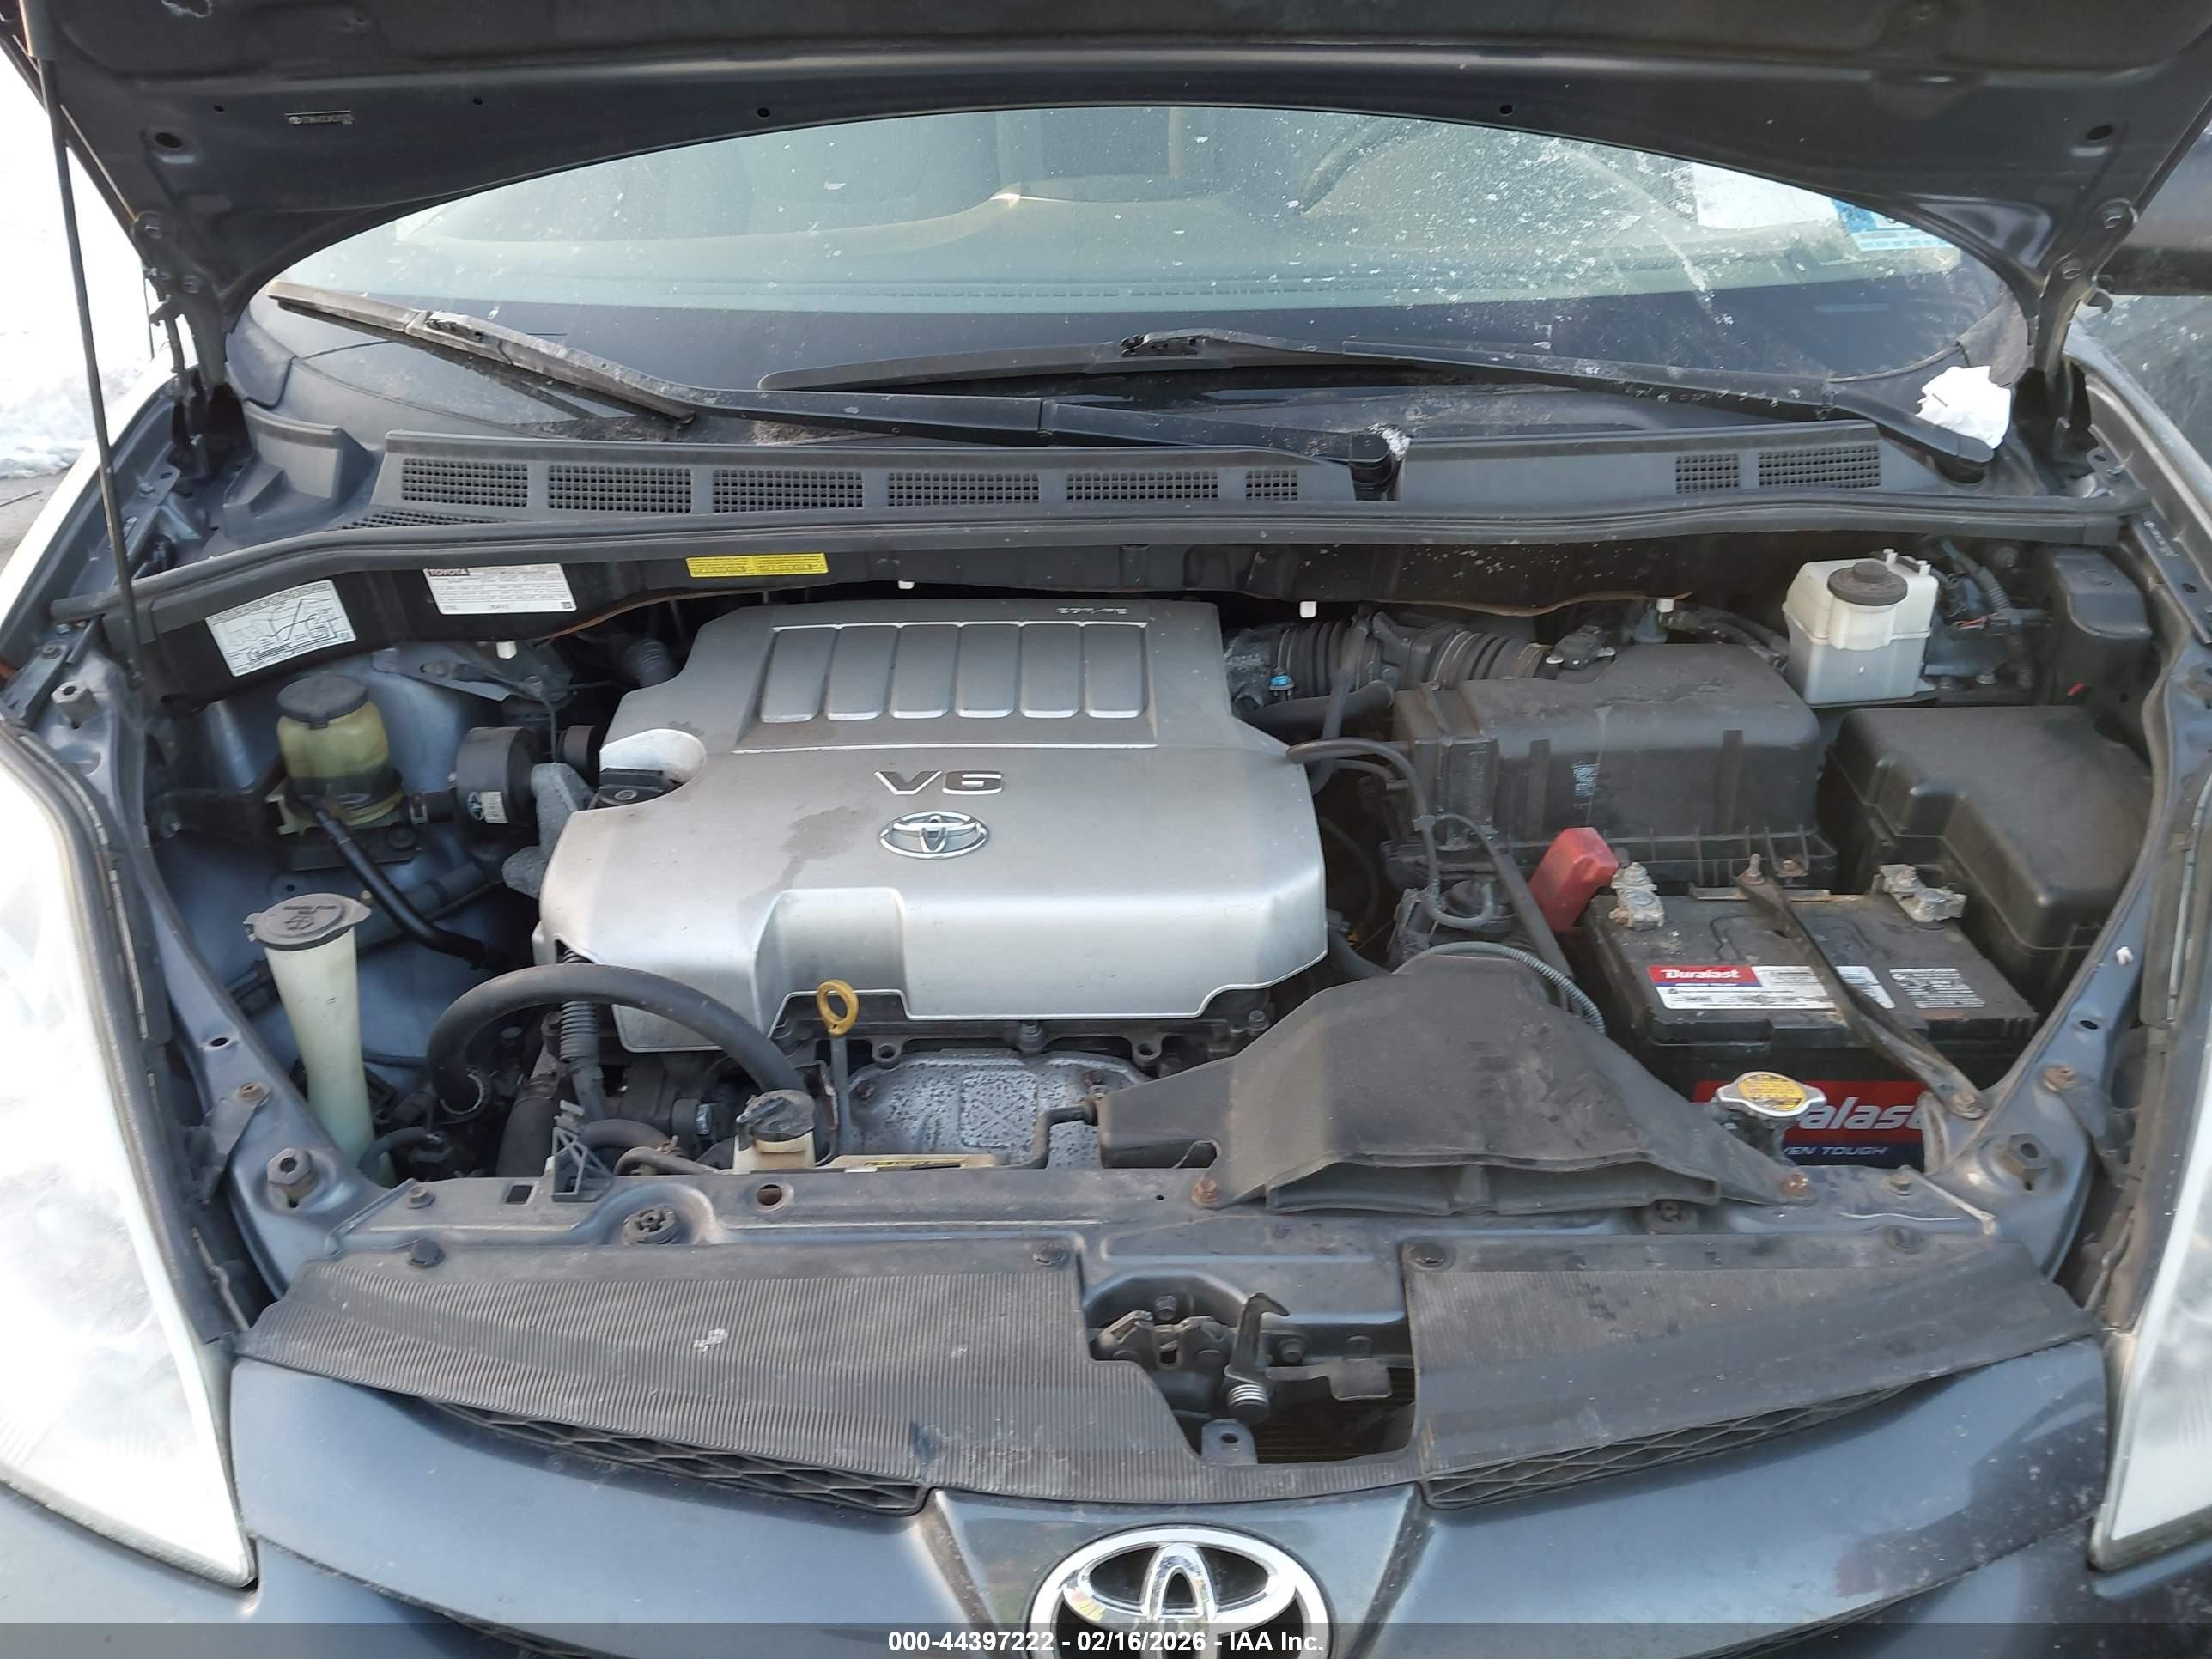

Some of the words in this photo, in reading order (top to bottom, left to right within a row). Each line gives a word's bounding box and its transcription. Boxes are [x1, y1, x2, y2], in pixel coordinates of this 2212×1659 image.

[873, 770, 1003, 795] V6
[1661, 969, 1741, 979] Duralast
[1821, 1146, 1889, 1155] TOUGH
